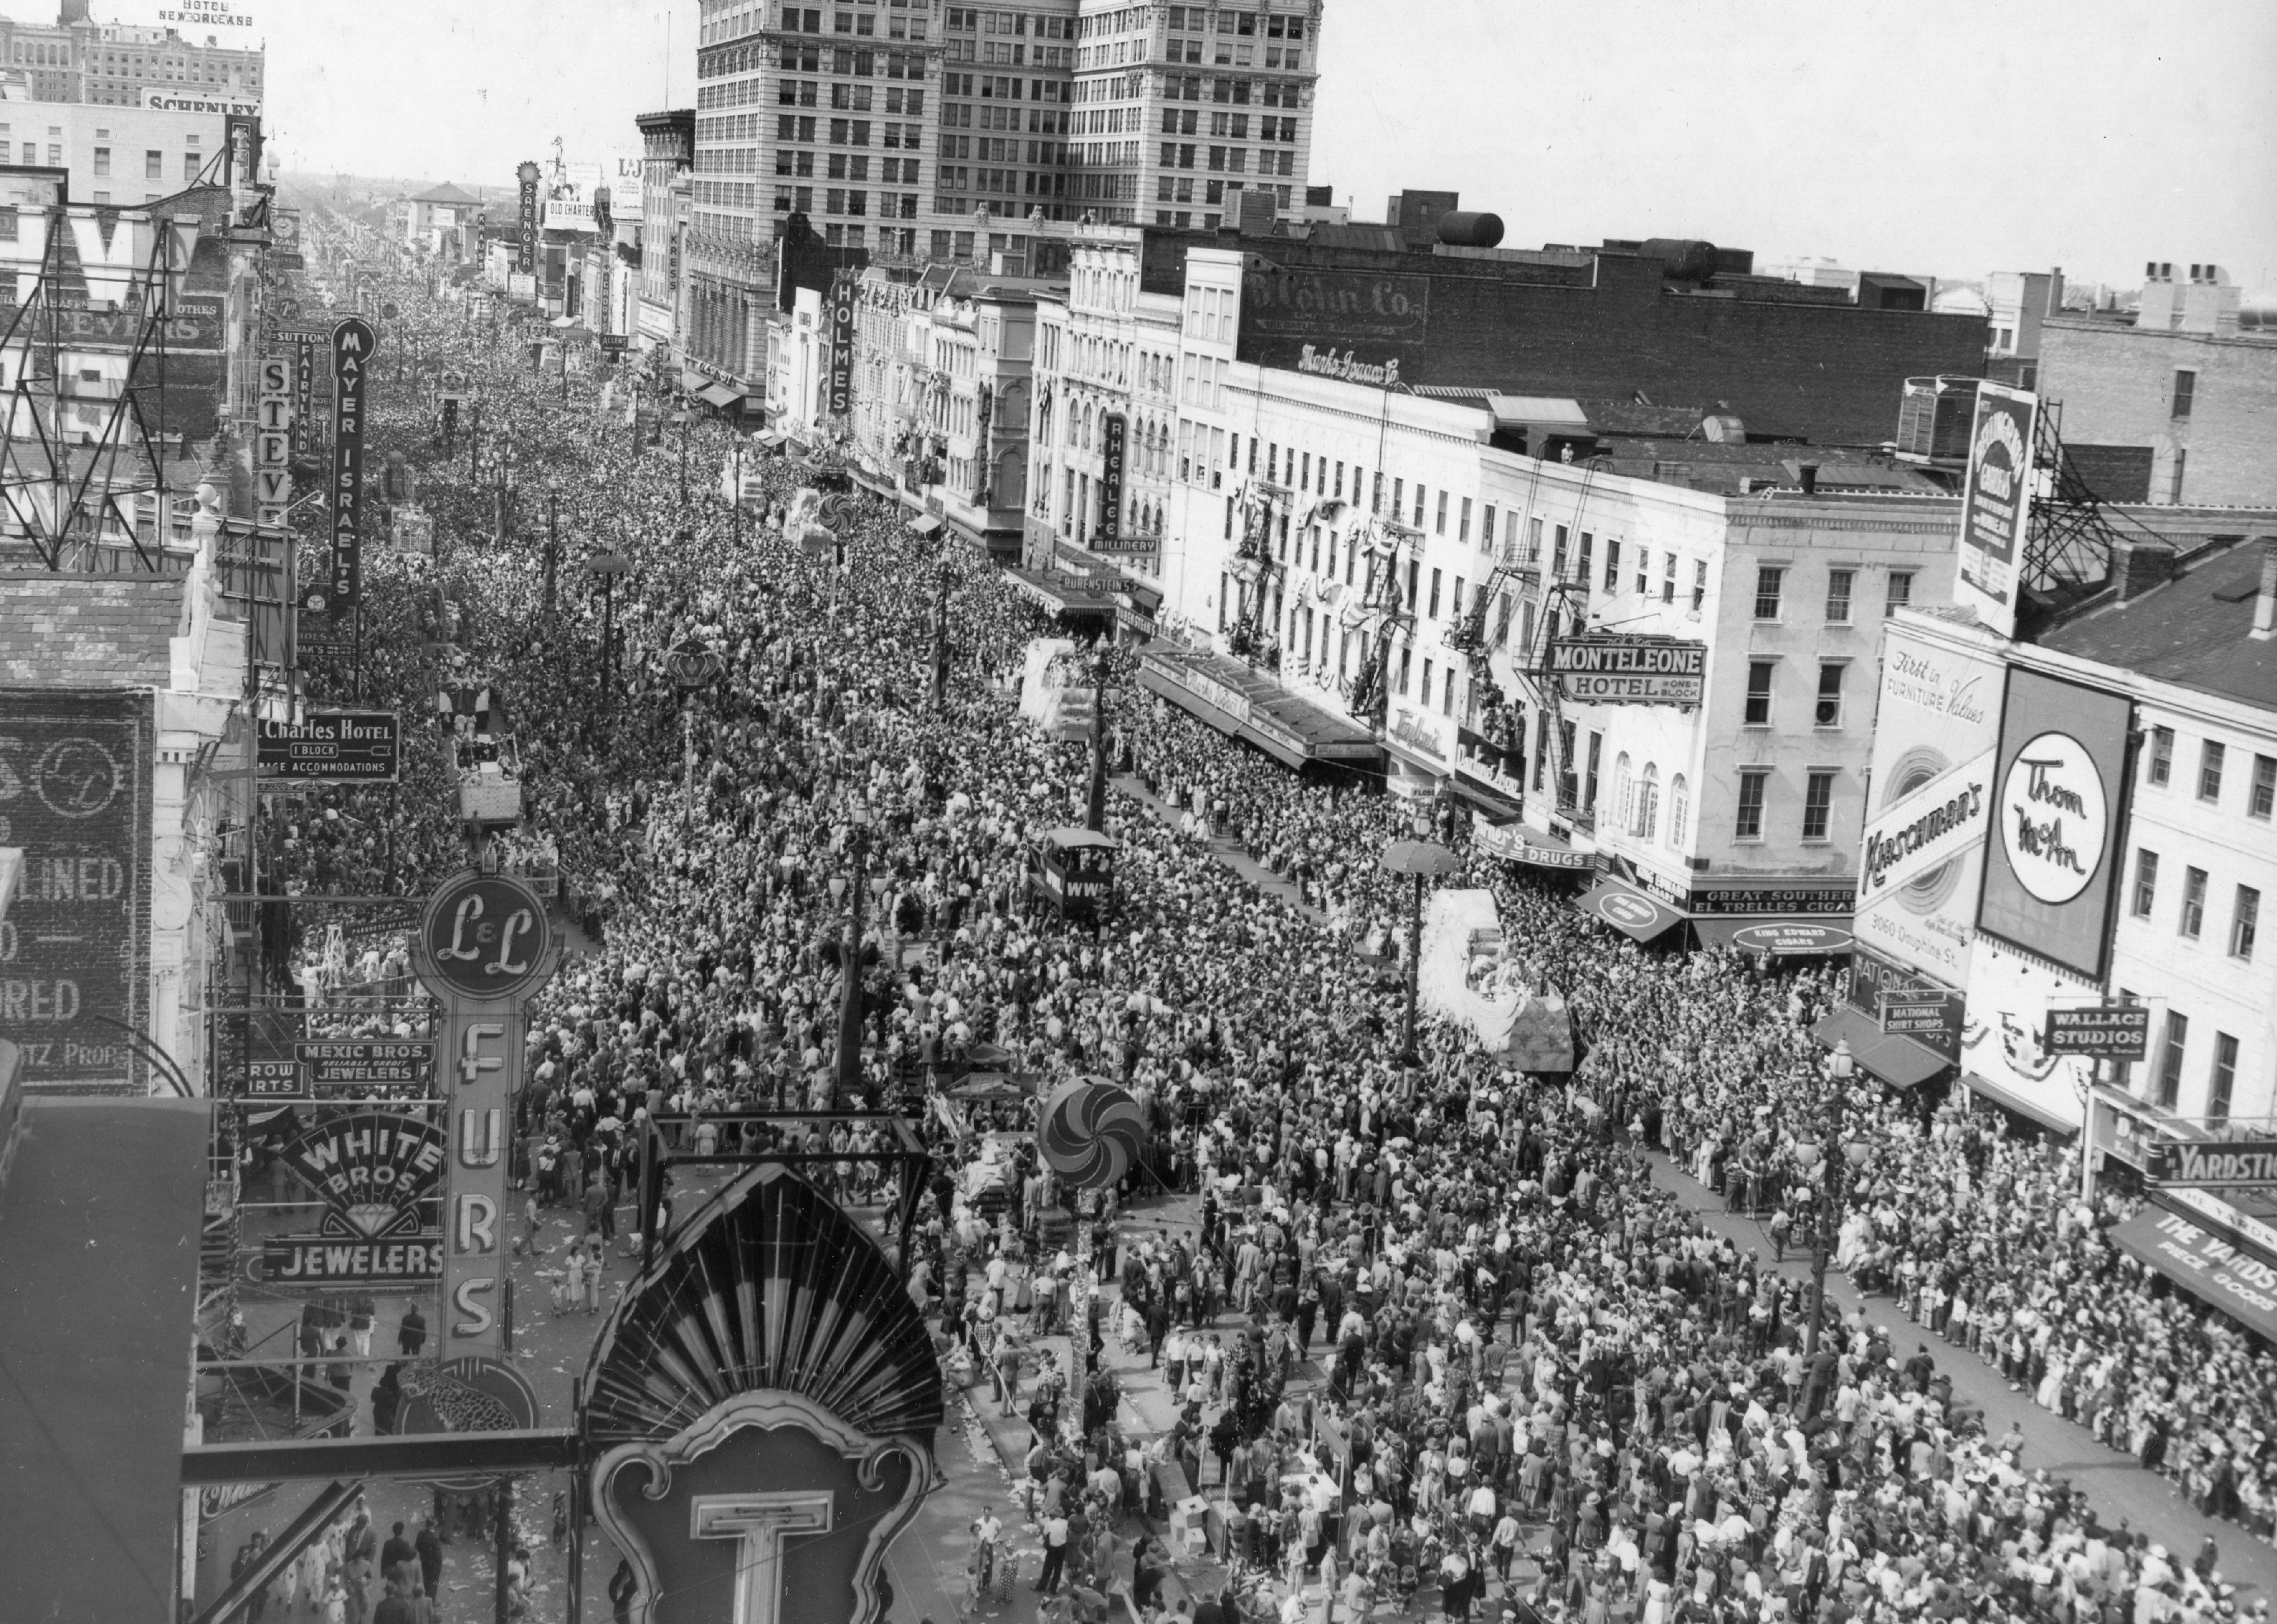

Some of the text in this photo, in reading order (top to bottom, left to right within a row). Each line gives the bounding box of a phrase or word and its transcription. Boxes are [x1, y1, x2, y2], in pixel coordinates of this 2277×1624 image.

[183, 0, 228, 12] HOTEL
[550, 203, 594, 217] OLD CHARTER
[522, 183, 533, 267] SAENGER
[669, 233, 678, 291] KRESS
[833, 285, 850, 409] HOLMES
[341, 332, 361, 433] MAYER
[299, 345, 310, 451] FAIRYLAND
[1105, 423, 1121, 535] RHEALEE
[1094, 541, 1154, 551] MILLINERY
[1552, 646, 1702, 673] MONTELEONE
[1892, 651, 1929, 679] First
[1575, 677, 1658, 696] HOTEL
[1660, 689, 1697, 697] BLOCK
[1887, 678, 1944, 711] FURNITURE
[1946, 676, 1984, 723] Values
[302, 746, 334, 755] BLOCK
[292, 762, 385, 771] ACCOMMODATIONS
[2017, 758, 2087, 819] Thom
[1528, 849, 1584, 866] DRUGS
[1646, 883, 1675, 904] CIGARS
[1707, 890, 1855, 901] GREAT SOUTHER
[1722, 902, 1797, 912] TRELLES
[1753, 928, 1826, 938] KING EDWARD
[1871, 913, 1895, 937] 3060
[1898, 926, 1941, 960] Dauphine
[1887, 1018, 1944, 1030] SHIRT SHOPS
[1892, 1008, 1941, 1018] NATIONAL
[2054, 1013, 2145, 1025] WALLACE
[2053, 1030, 2144, 1044] STUDIOS
[305, 1045, 427, 1058] MEXIC BROS.
[317, 1067, 412, 1080] JEWELERS
[300, 1128, 445, 1173] WHITE
[328, 1166, 417, 1196] BROS.
[453, 1022, 505, 1336] FURS
[2156, 1213, 2206, 1245] THE
[281, 1245, 443, 1276] JEWELERS
[2157, 1241, 2277, 1311] PIECE GOODS
